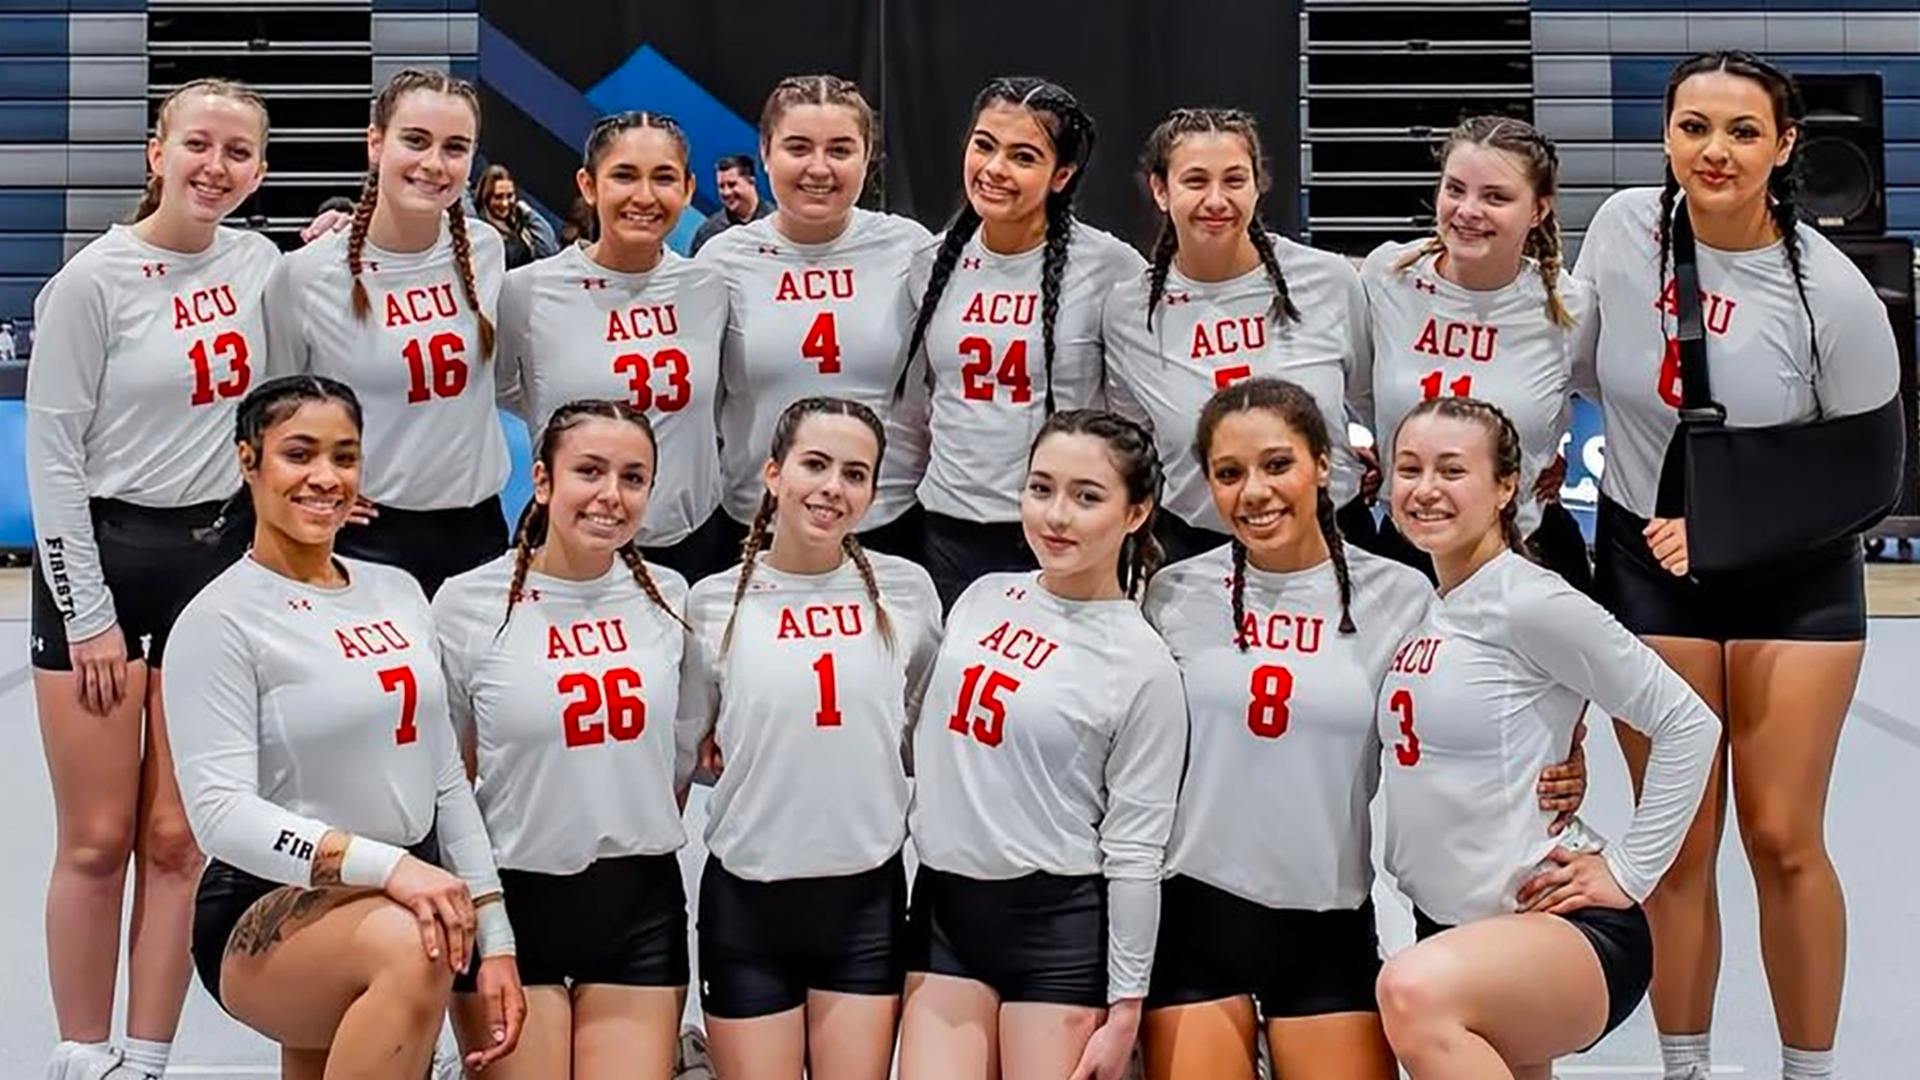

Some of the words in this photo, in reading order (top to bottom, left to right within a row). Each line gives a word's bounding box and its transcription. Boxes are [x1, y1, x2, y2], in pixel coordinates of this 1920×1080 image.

[174, 285, 239, 331] ACU
[386, 284, 458, 328] ACU
[774, 266, 854, 302] ACU
[1656, 279, 1736, 335] AU
[606, 305, 679, 342] ACU
[962, 293, 1037, 326] ACU
[801, 312, 842, 374] 4
[1191, 315, 1266, 359] ACU
[1414, 317, 1497, 363] ACU
[188, 331, 252, 406] 13
[402, 332, 468, 404] 16
[613, 348, 692, 412] 33
[958, 337, 1033, 404] 24
[335, 620, 411, 659] ACU
[546, 618, 629, 660] ACU
[778, 604, 863, 640] ACU
[978, 621, 1059, 671] ACU
[1234, 612, 1323, 654] ACU
[1389, 638, 1441, 674] ACU
[377, 665, 419, 746] 7
[557, 666, 647, 748] 26
[812, 652, 842, 727] 1
[948, 663, 1022, 749] 15
[1247, 664, 1295, 740] 8
[1390, 689, 1421, 767] 3
